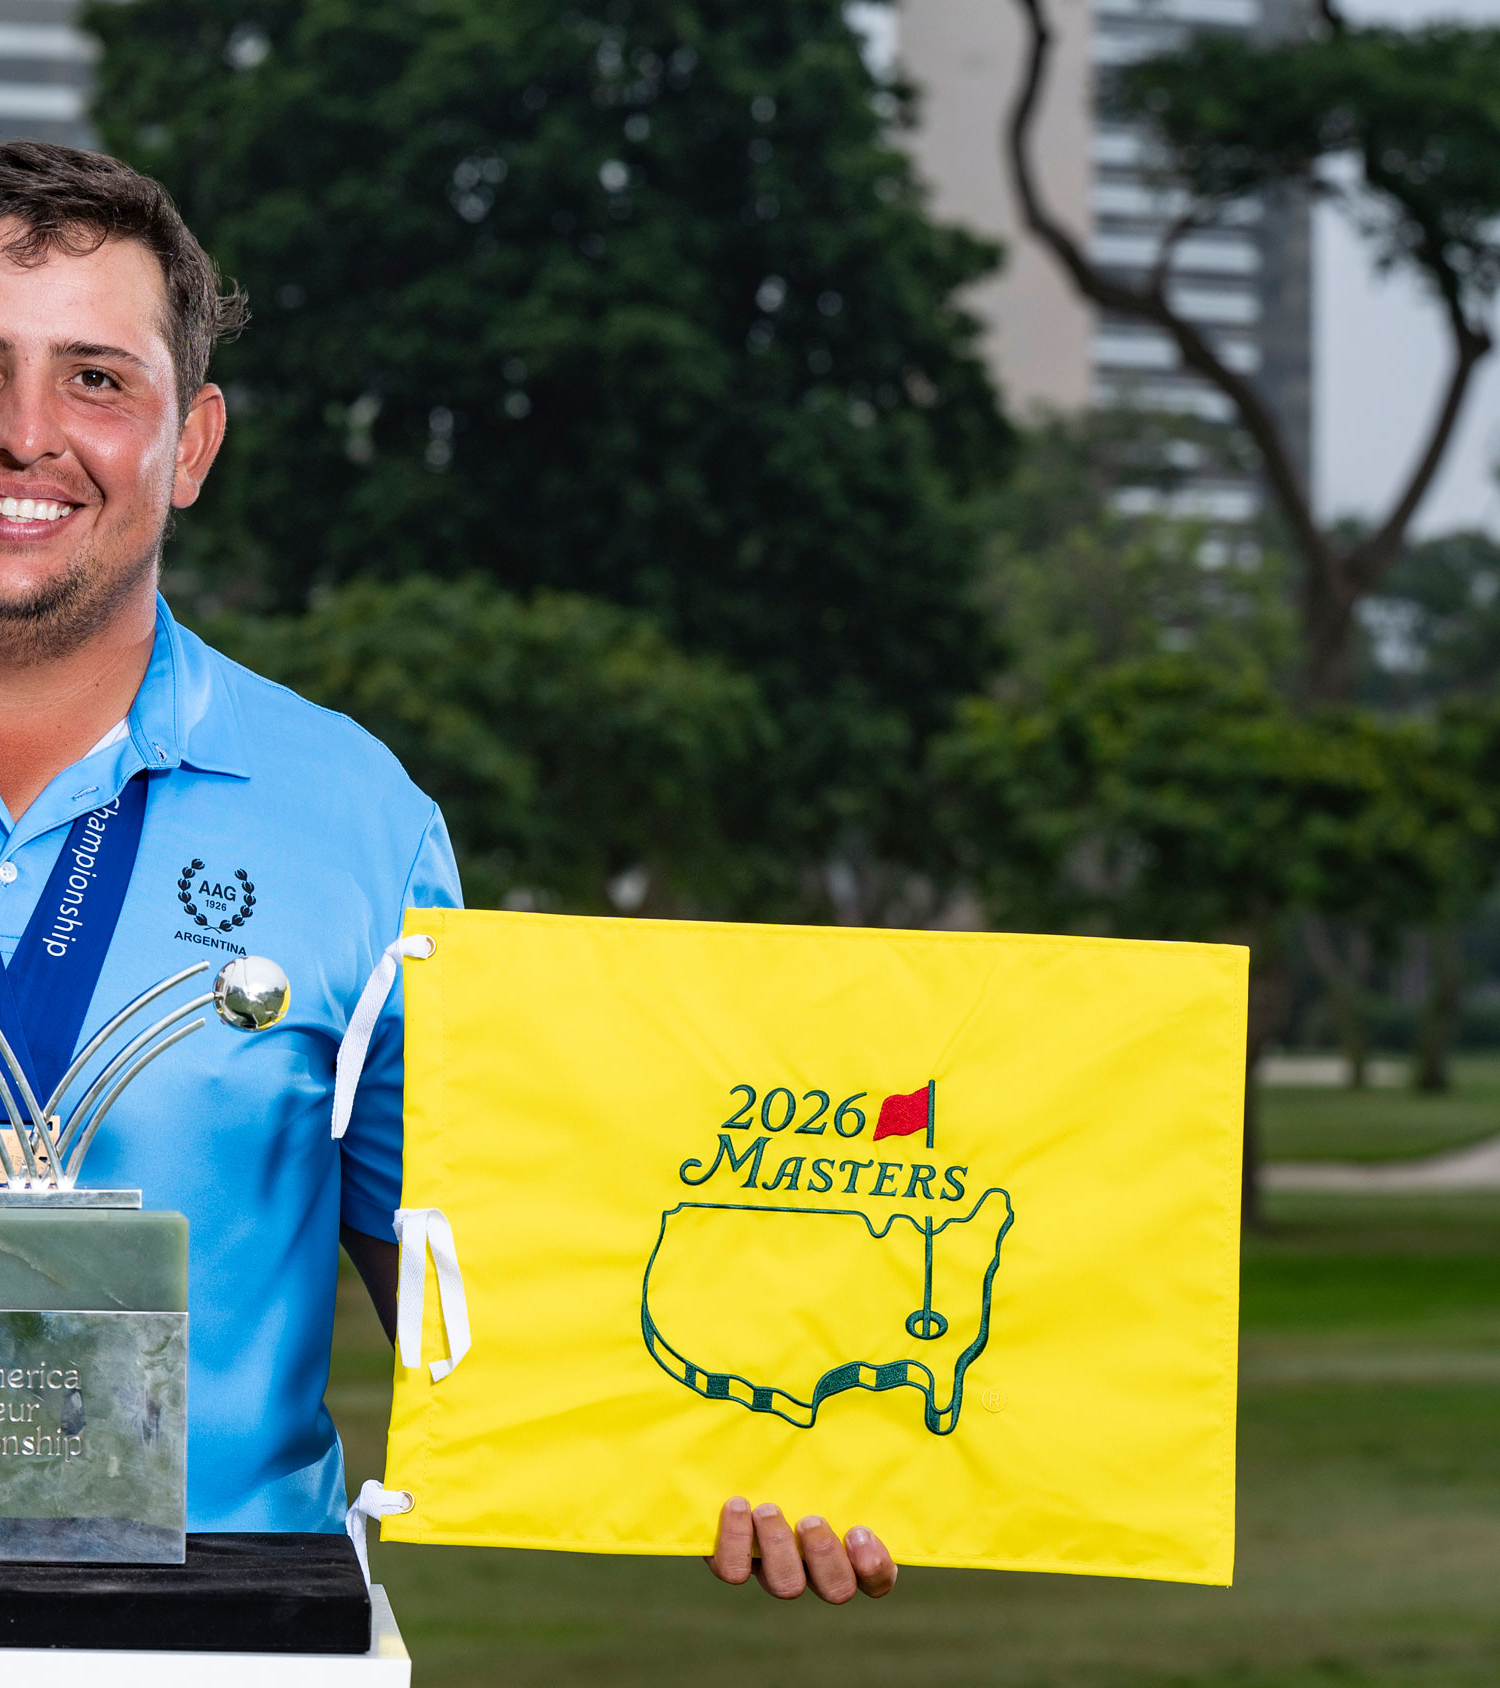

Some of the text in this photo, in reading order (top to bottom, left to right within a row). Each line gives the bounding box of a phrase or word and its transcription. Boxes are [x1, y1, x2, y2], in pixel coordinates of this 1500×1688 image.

[198, 880, 237, 902] AAG
[205, 899, 227, 912] 1926
[174, 930, 247, 956] ARGENTINA
[720, 1084, 868, 1138] 2026
[679, 1134, 969, 1201] MASTERS
